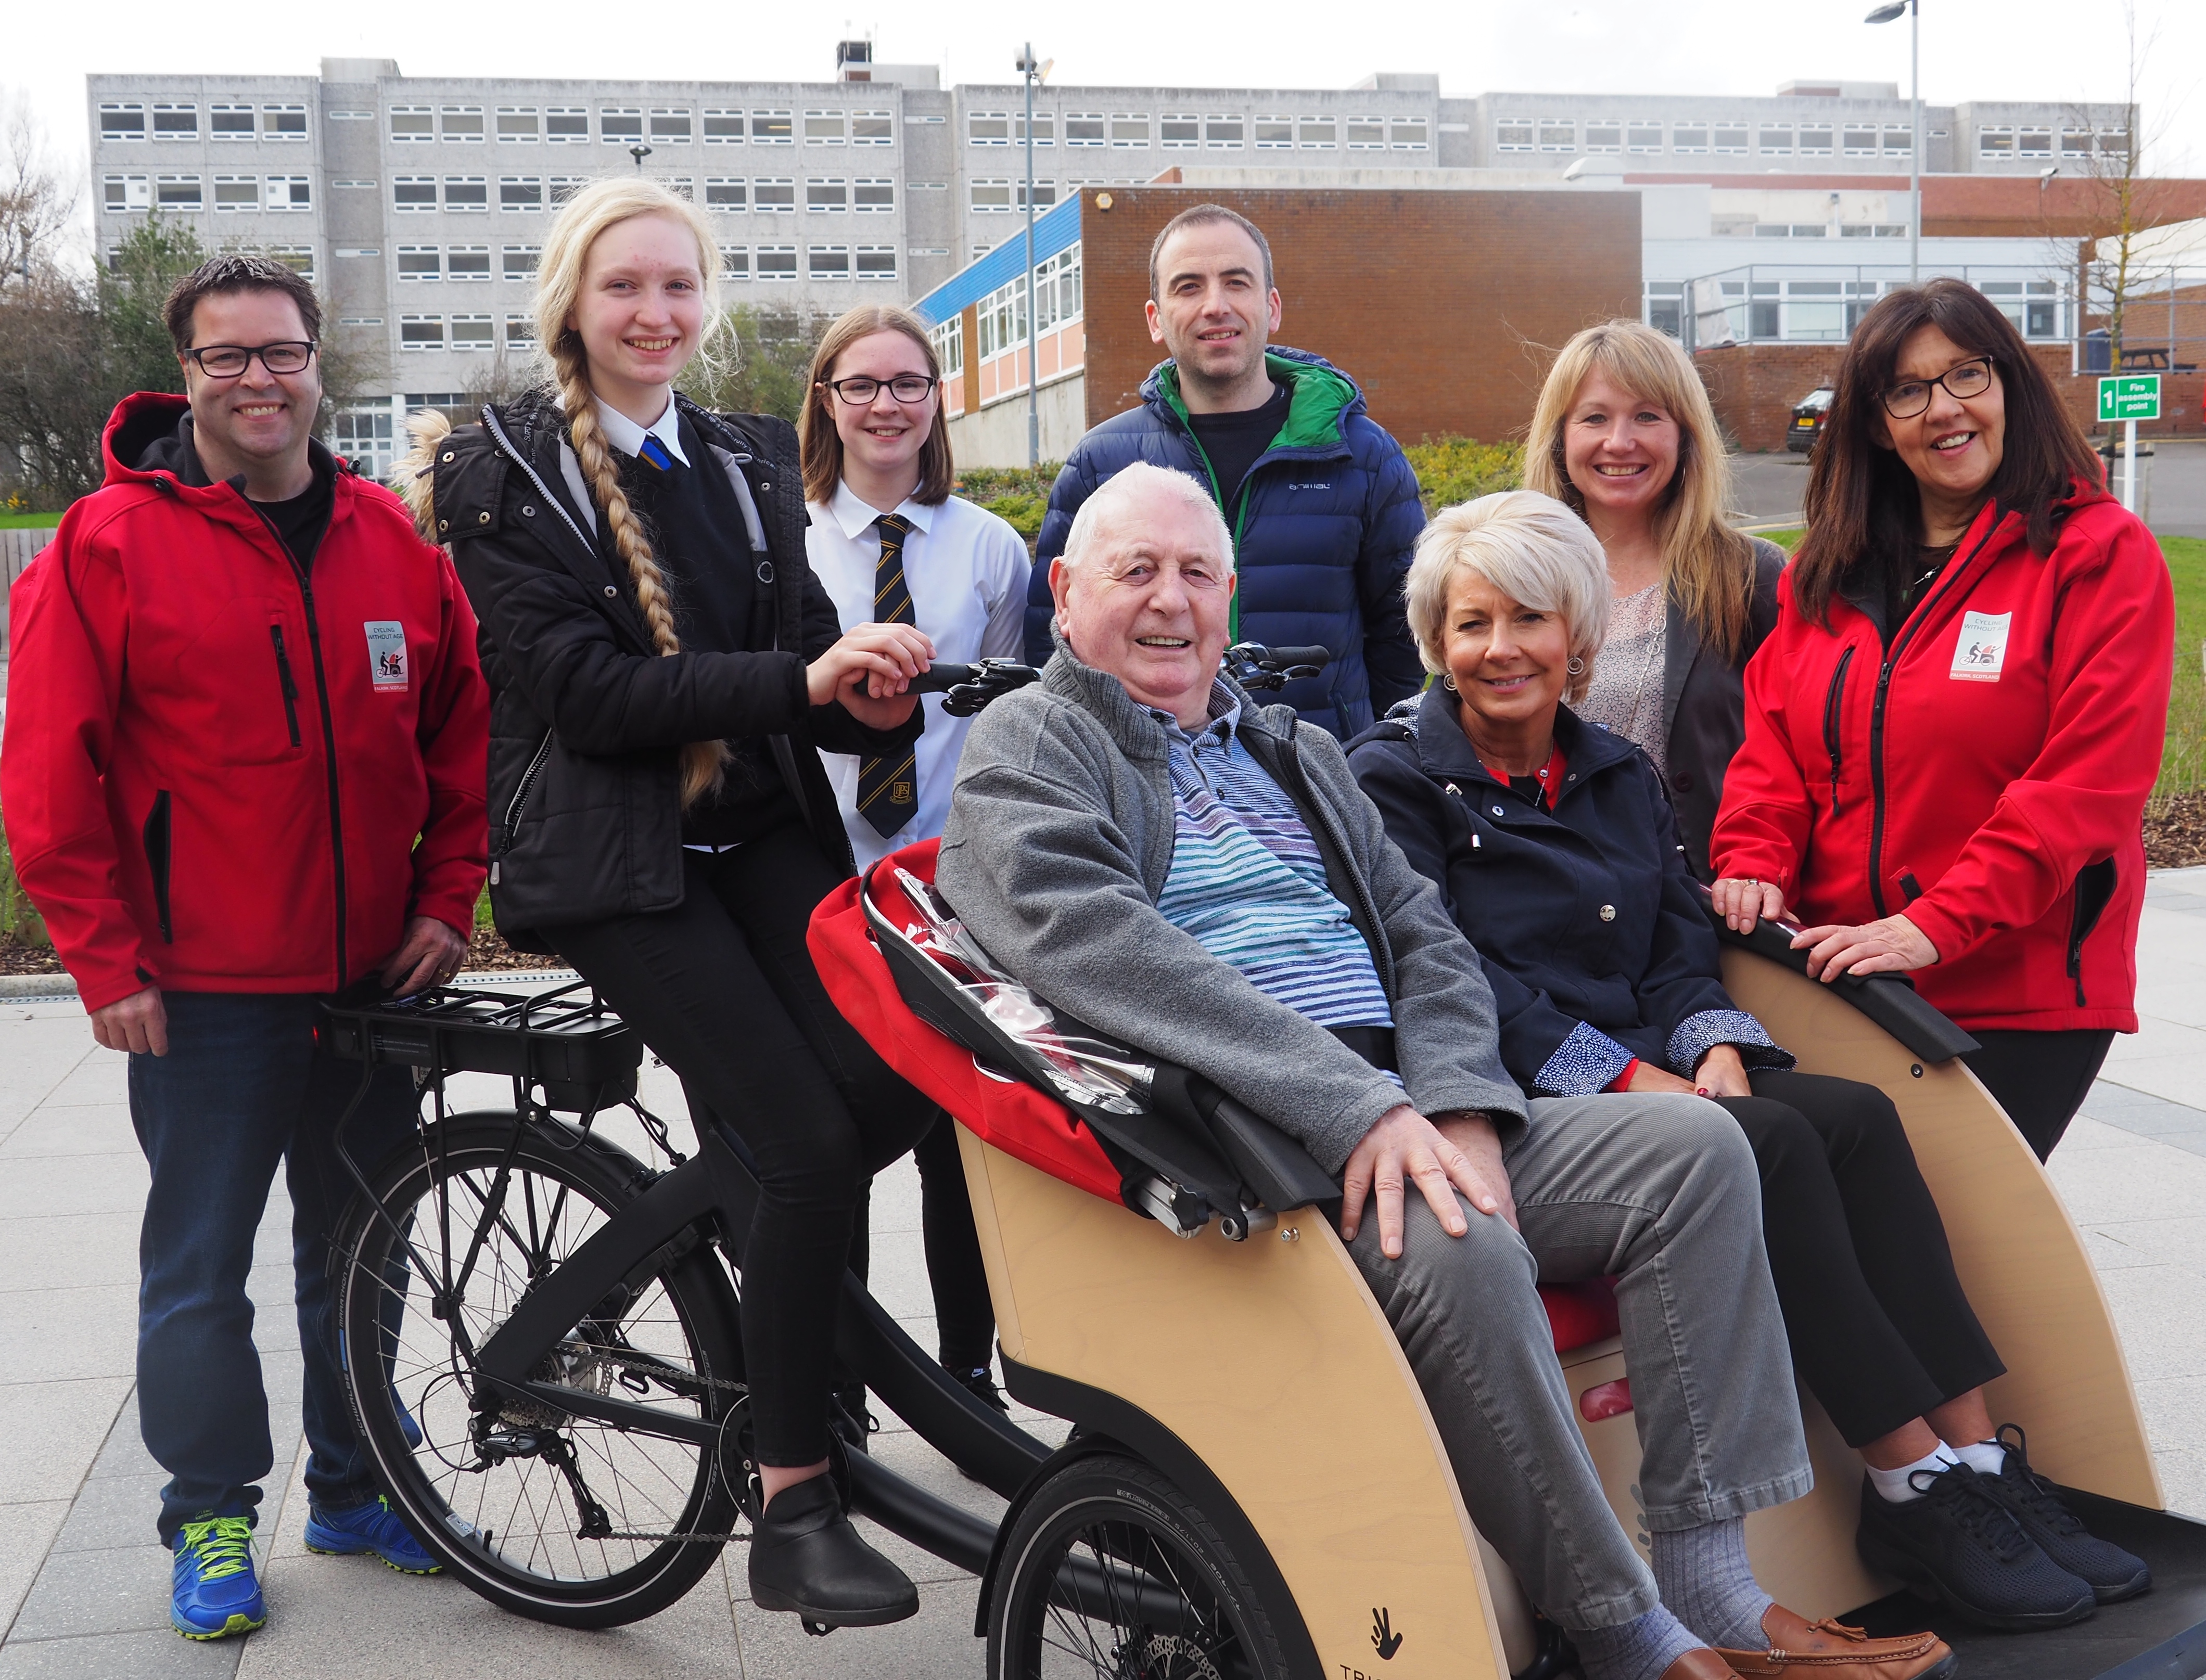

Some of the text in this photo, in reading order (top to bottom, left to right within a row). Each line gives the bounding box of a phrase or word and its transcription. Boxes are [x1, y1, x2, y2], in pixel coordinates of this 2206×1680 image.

[2103, 390, 2113, 409] 1
[2119, 392, 2157, 402] assembly
[2126, 402, 2148, 412] point
[1963, 623, 1996, 632] WITHOUT
[338, 1243, 355, 1328] MARATHON PLUS
[343, 1373, 367, 1437] SCHWALBE
[707, 1463, 718, 1501] 47-559
